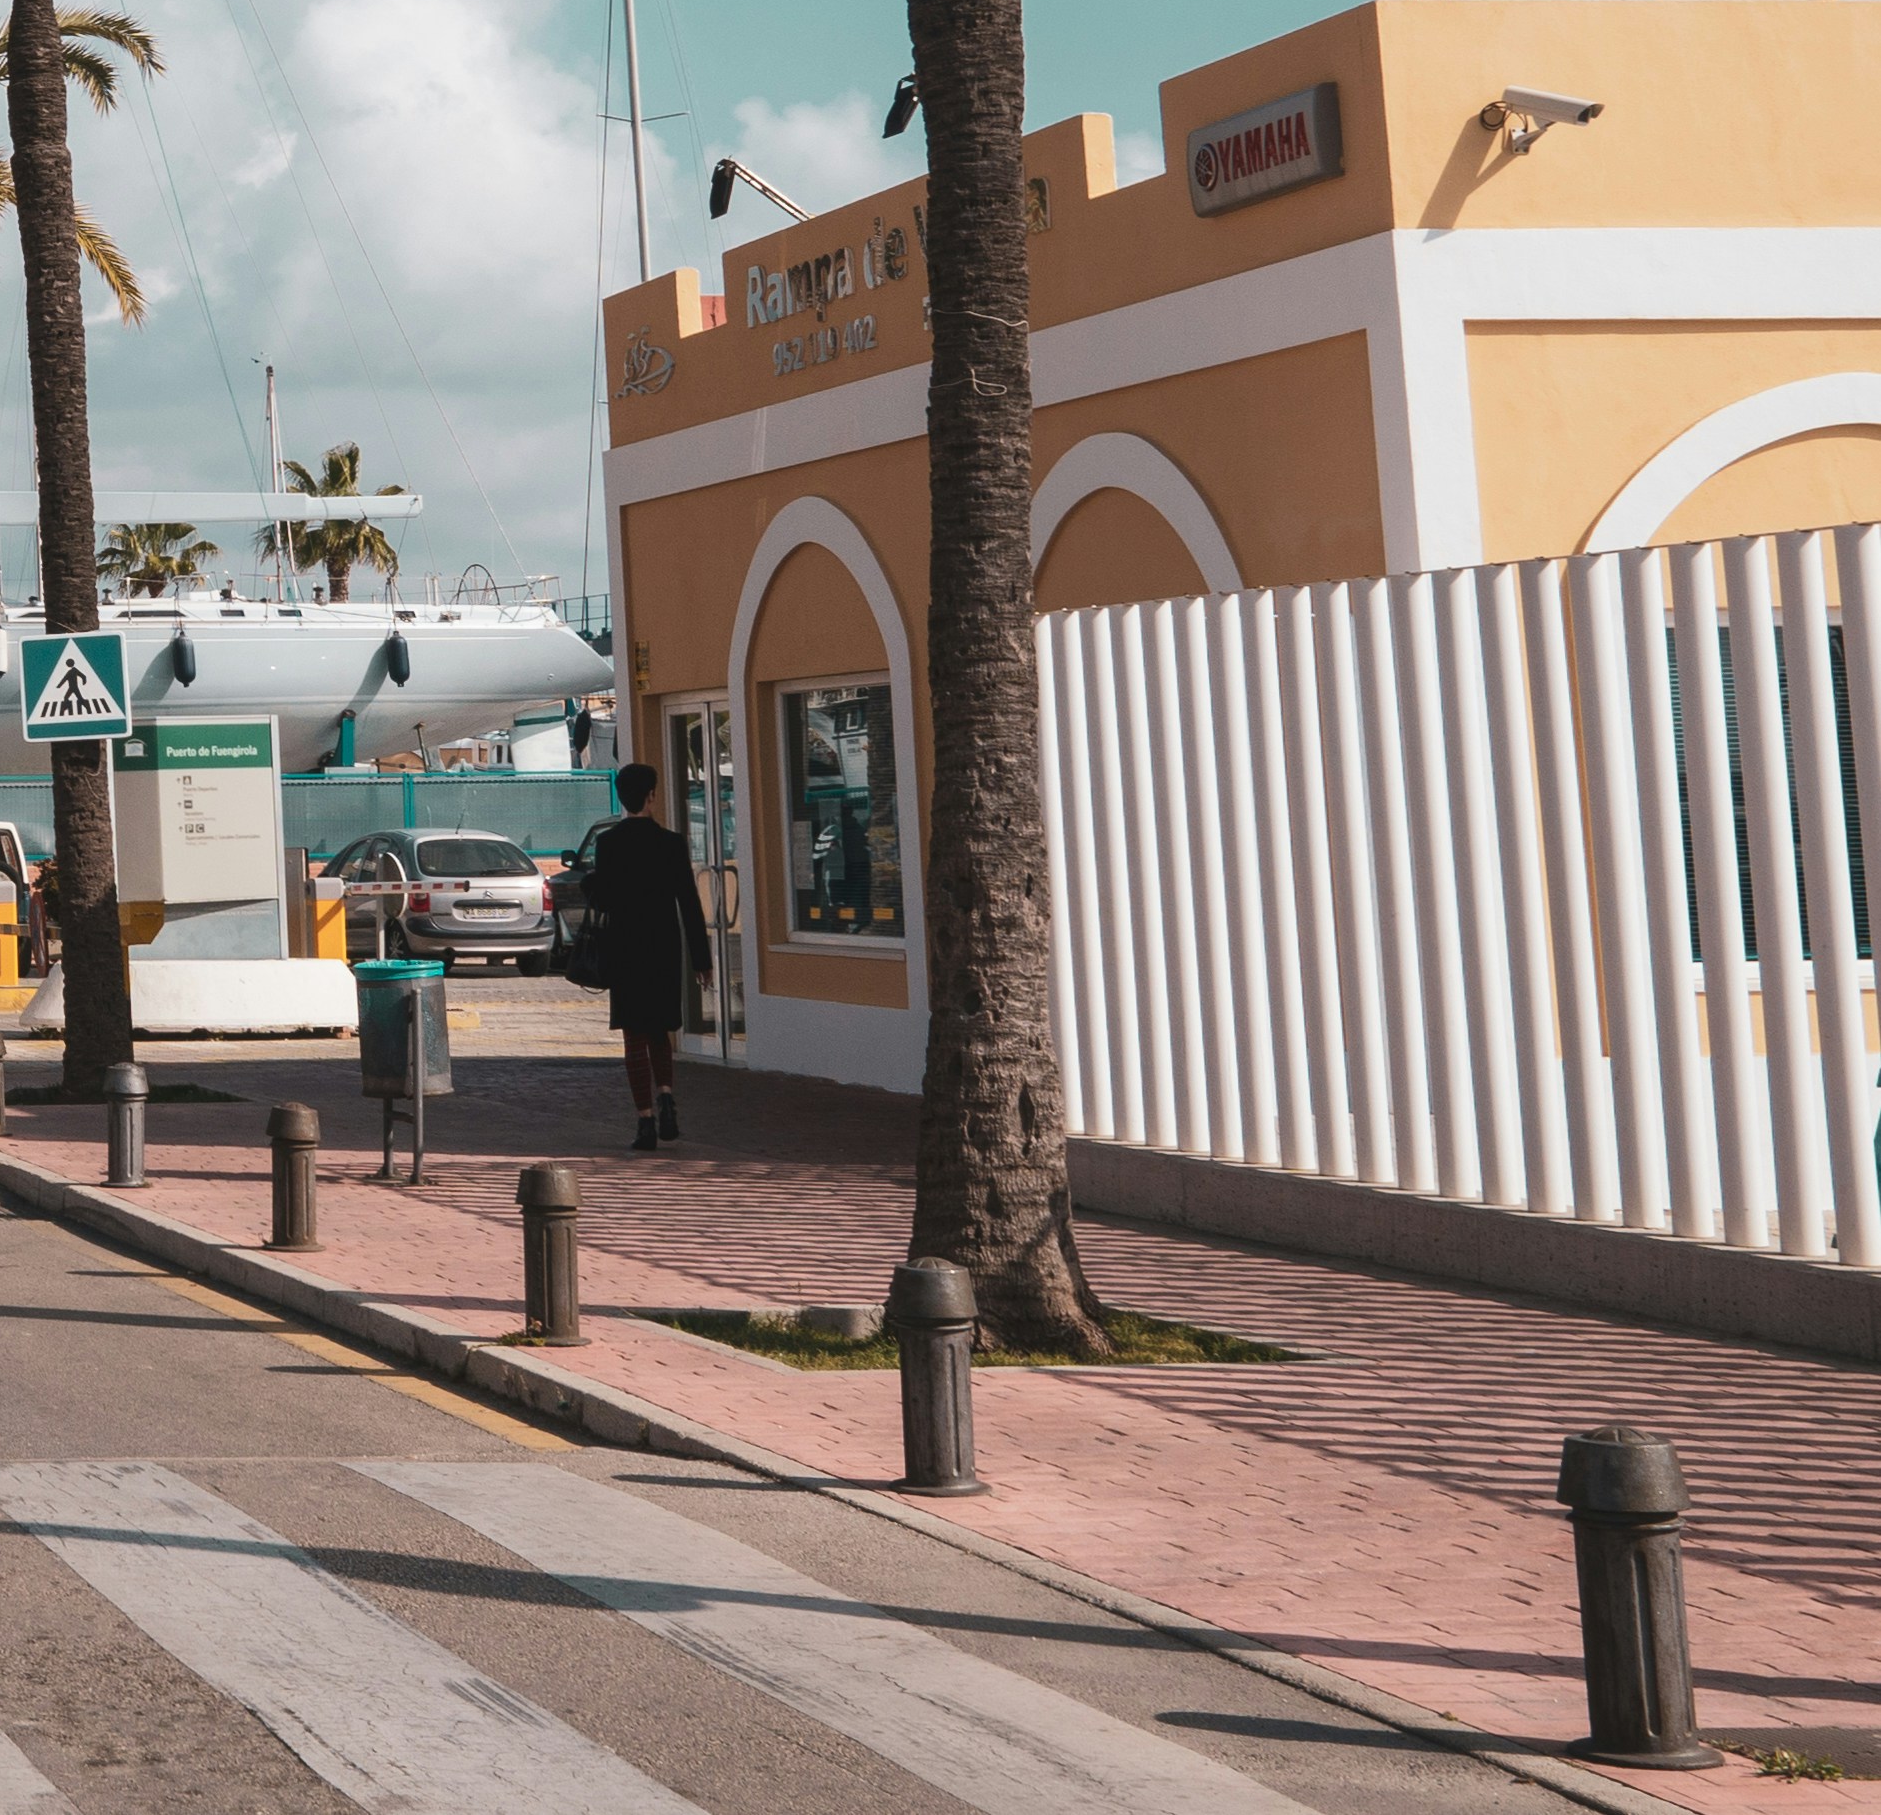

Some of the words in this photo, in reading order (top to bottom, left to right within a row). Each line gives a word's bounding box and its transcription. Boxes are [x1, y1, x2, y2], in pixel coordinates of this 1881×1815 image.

[1217, 111, 1311, 184] YAMAHA
[747, 246, 855, 329] Rampa
[863, 216, 908, 290] de
[773, 336, 806, 377] 952
[166, 746, 196, 757] Puerto
[198, 745, 209, 756] de
[211, 744, 258, 757] Fuengirola
